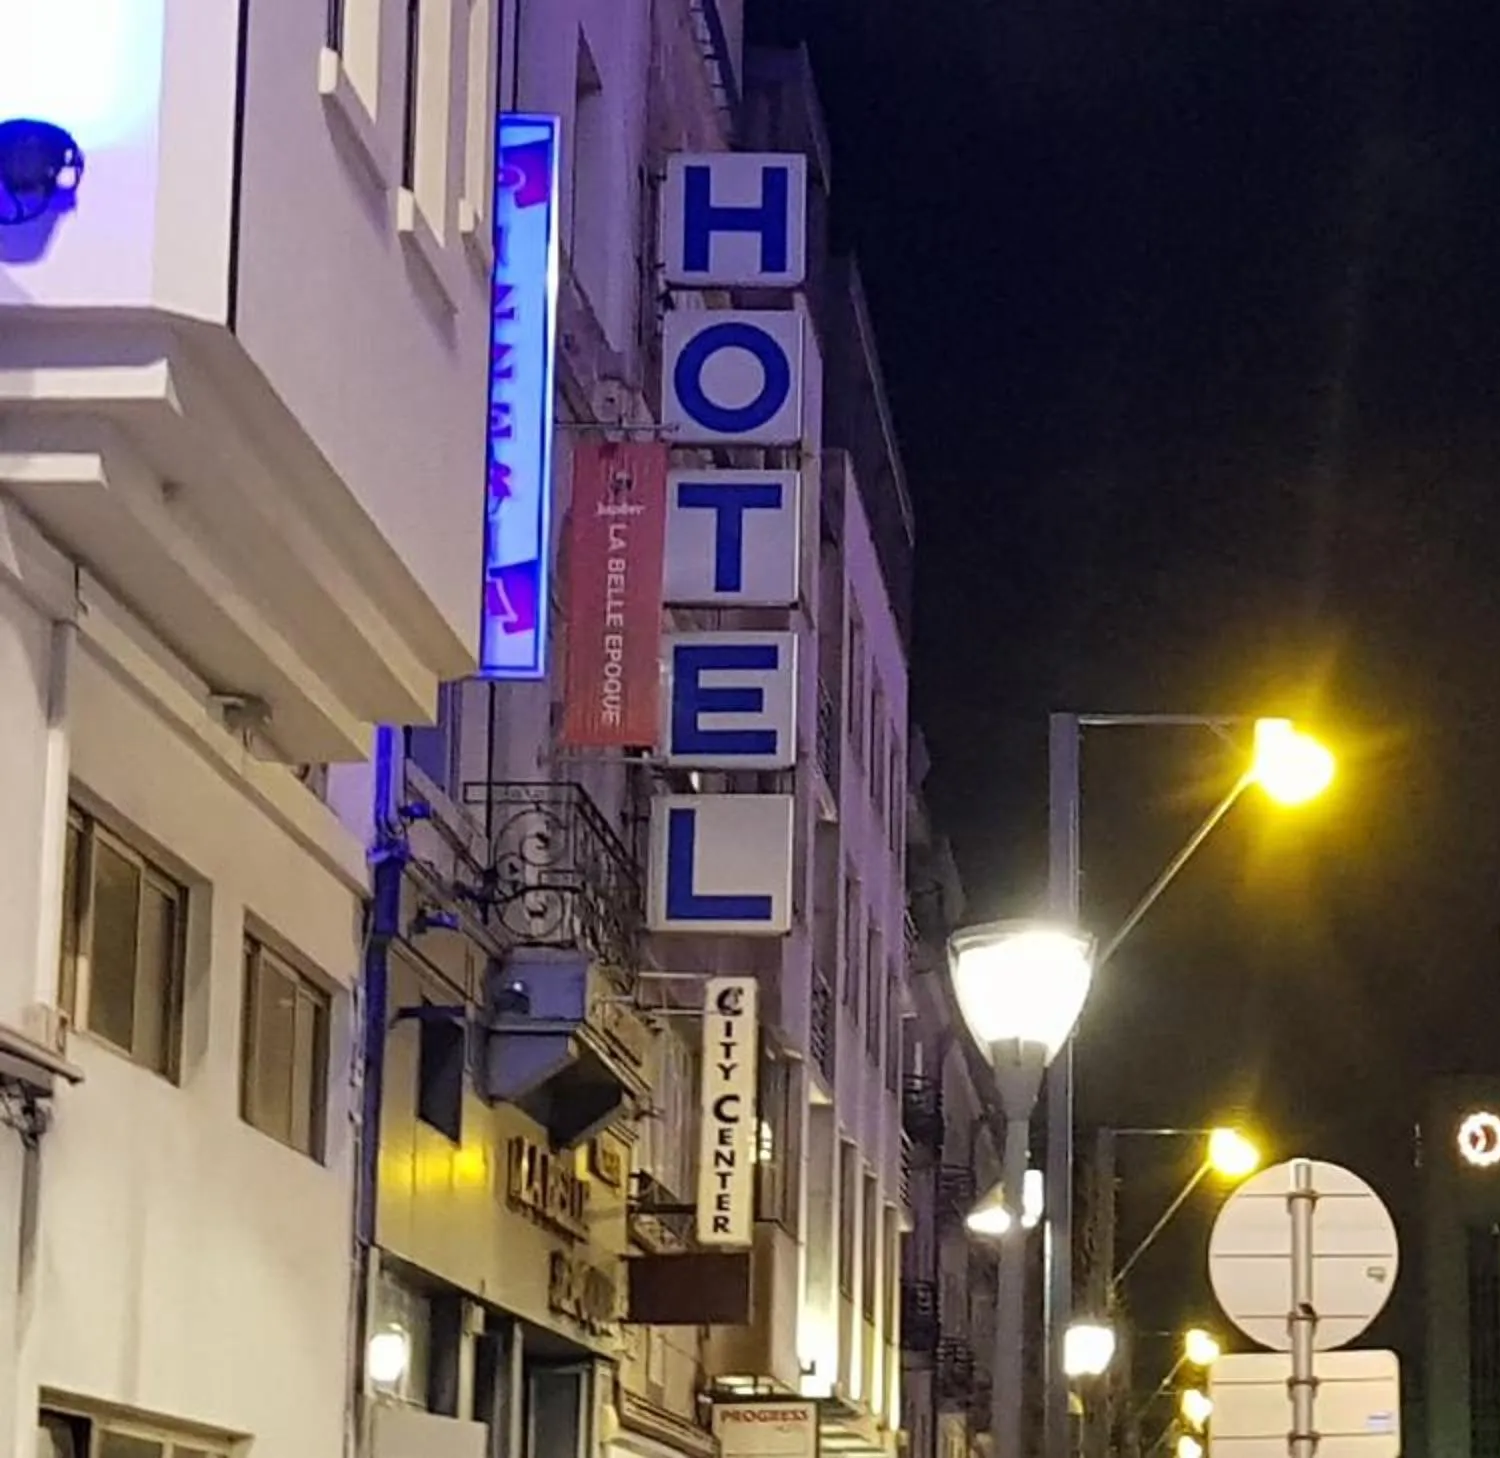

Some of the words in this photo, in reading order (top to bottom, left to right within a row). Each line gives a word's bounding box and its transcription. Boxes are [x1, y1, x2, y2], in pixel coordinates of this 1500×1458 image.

[607, 523, 628, 552] LA
[665, 164, 791, 921] HOTEL
[605, 558, 627, 628] BELLE
[601, 633, 625, 727] EPOQUE
[715, 986, 745, 1081] CITY
[712, 1093, 741, 1235] CENTER
[720, 1408, 809, 1423] PROGRESS
